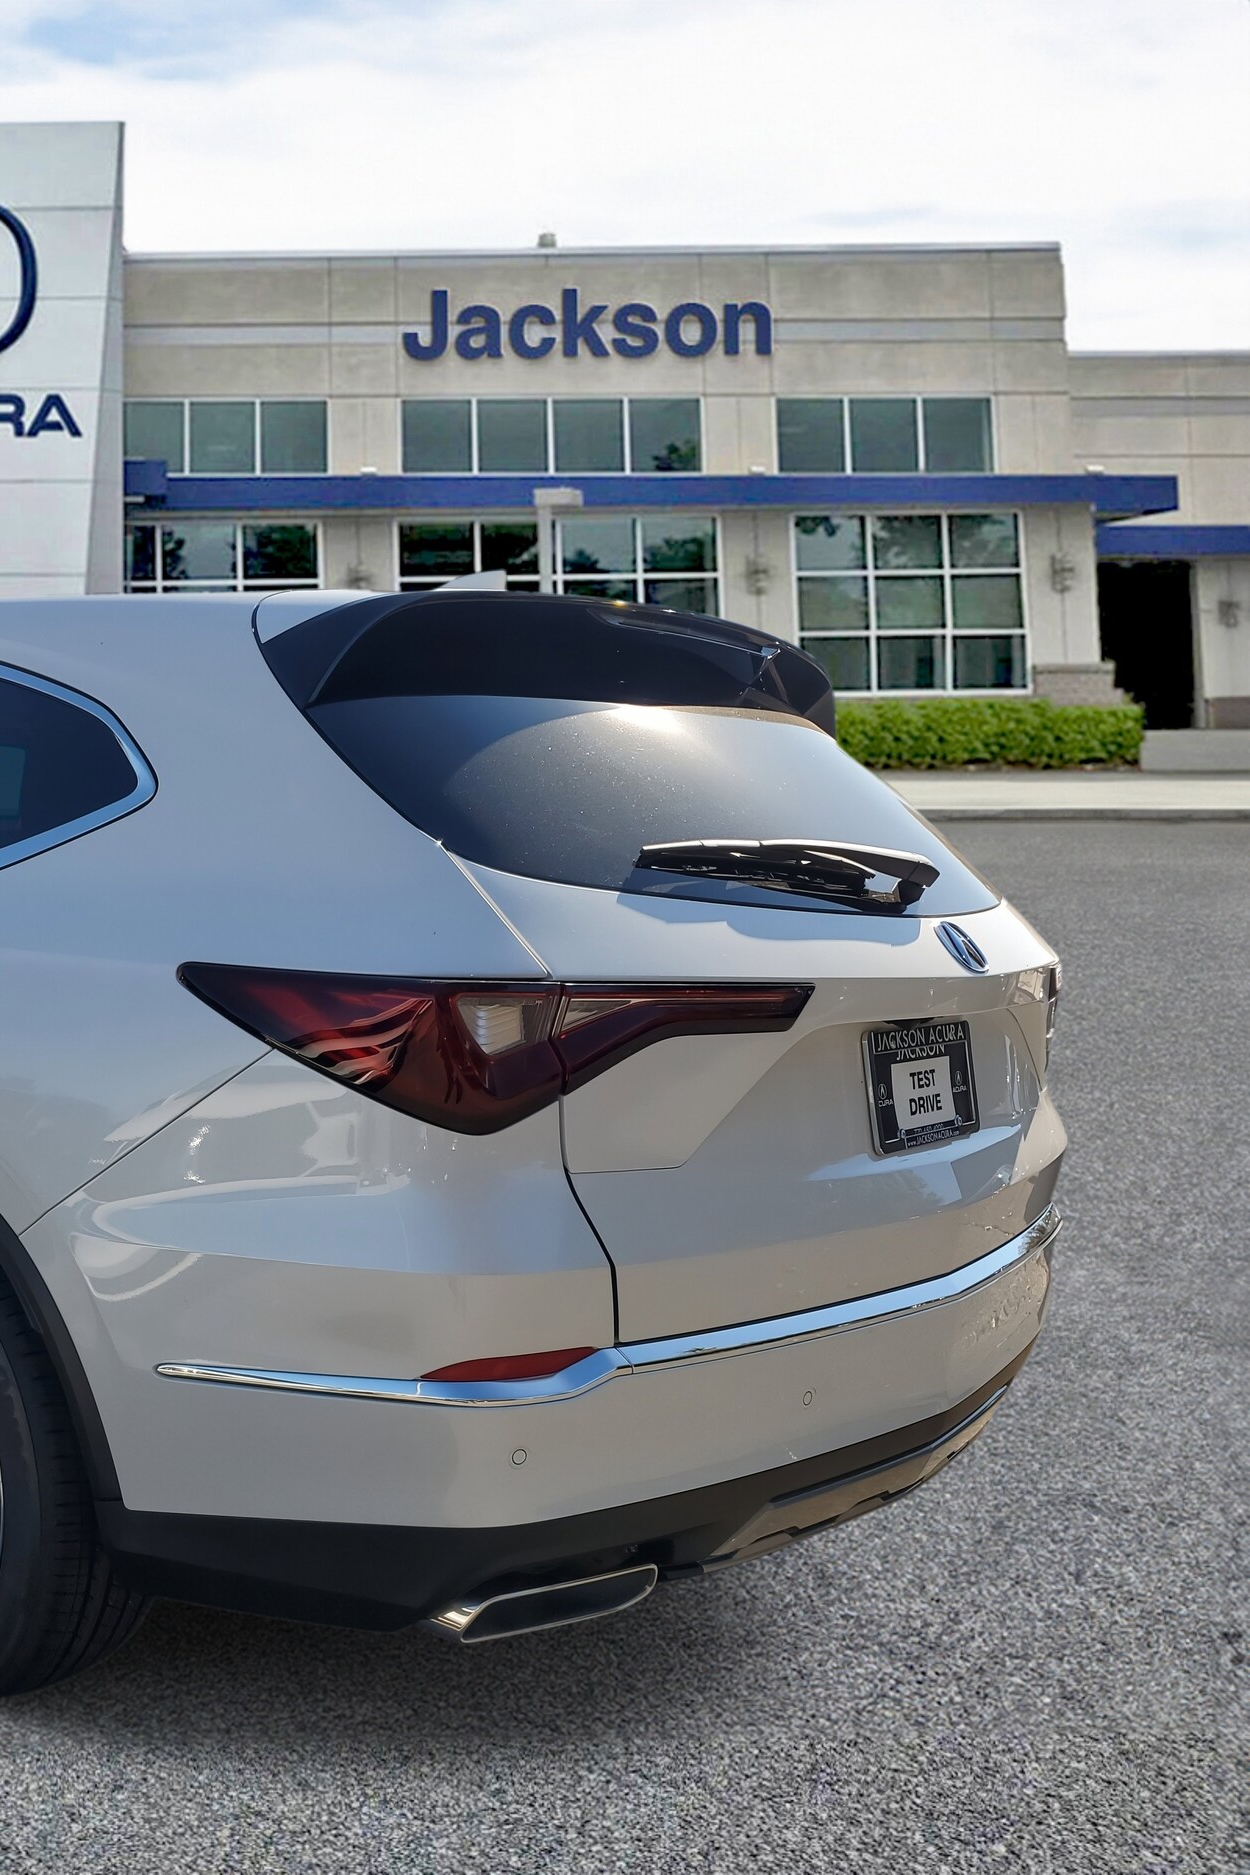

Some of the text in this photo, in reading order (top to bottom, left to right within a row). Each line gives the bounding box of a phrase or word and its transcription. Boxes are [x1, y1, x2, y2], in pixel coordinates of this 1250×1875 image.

[402, 288, 772, 361] Jackson
[877, 1023, 964, 1051] JACKSON ACURA
[909, 1069, 936, 1090] TEST
[909, 1093, 943, 1116] DRIVE
